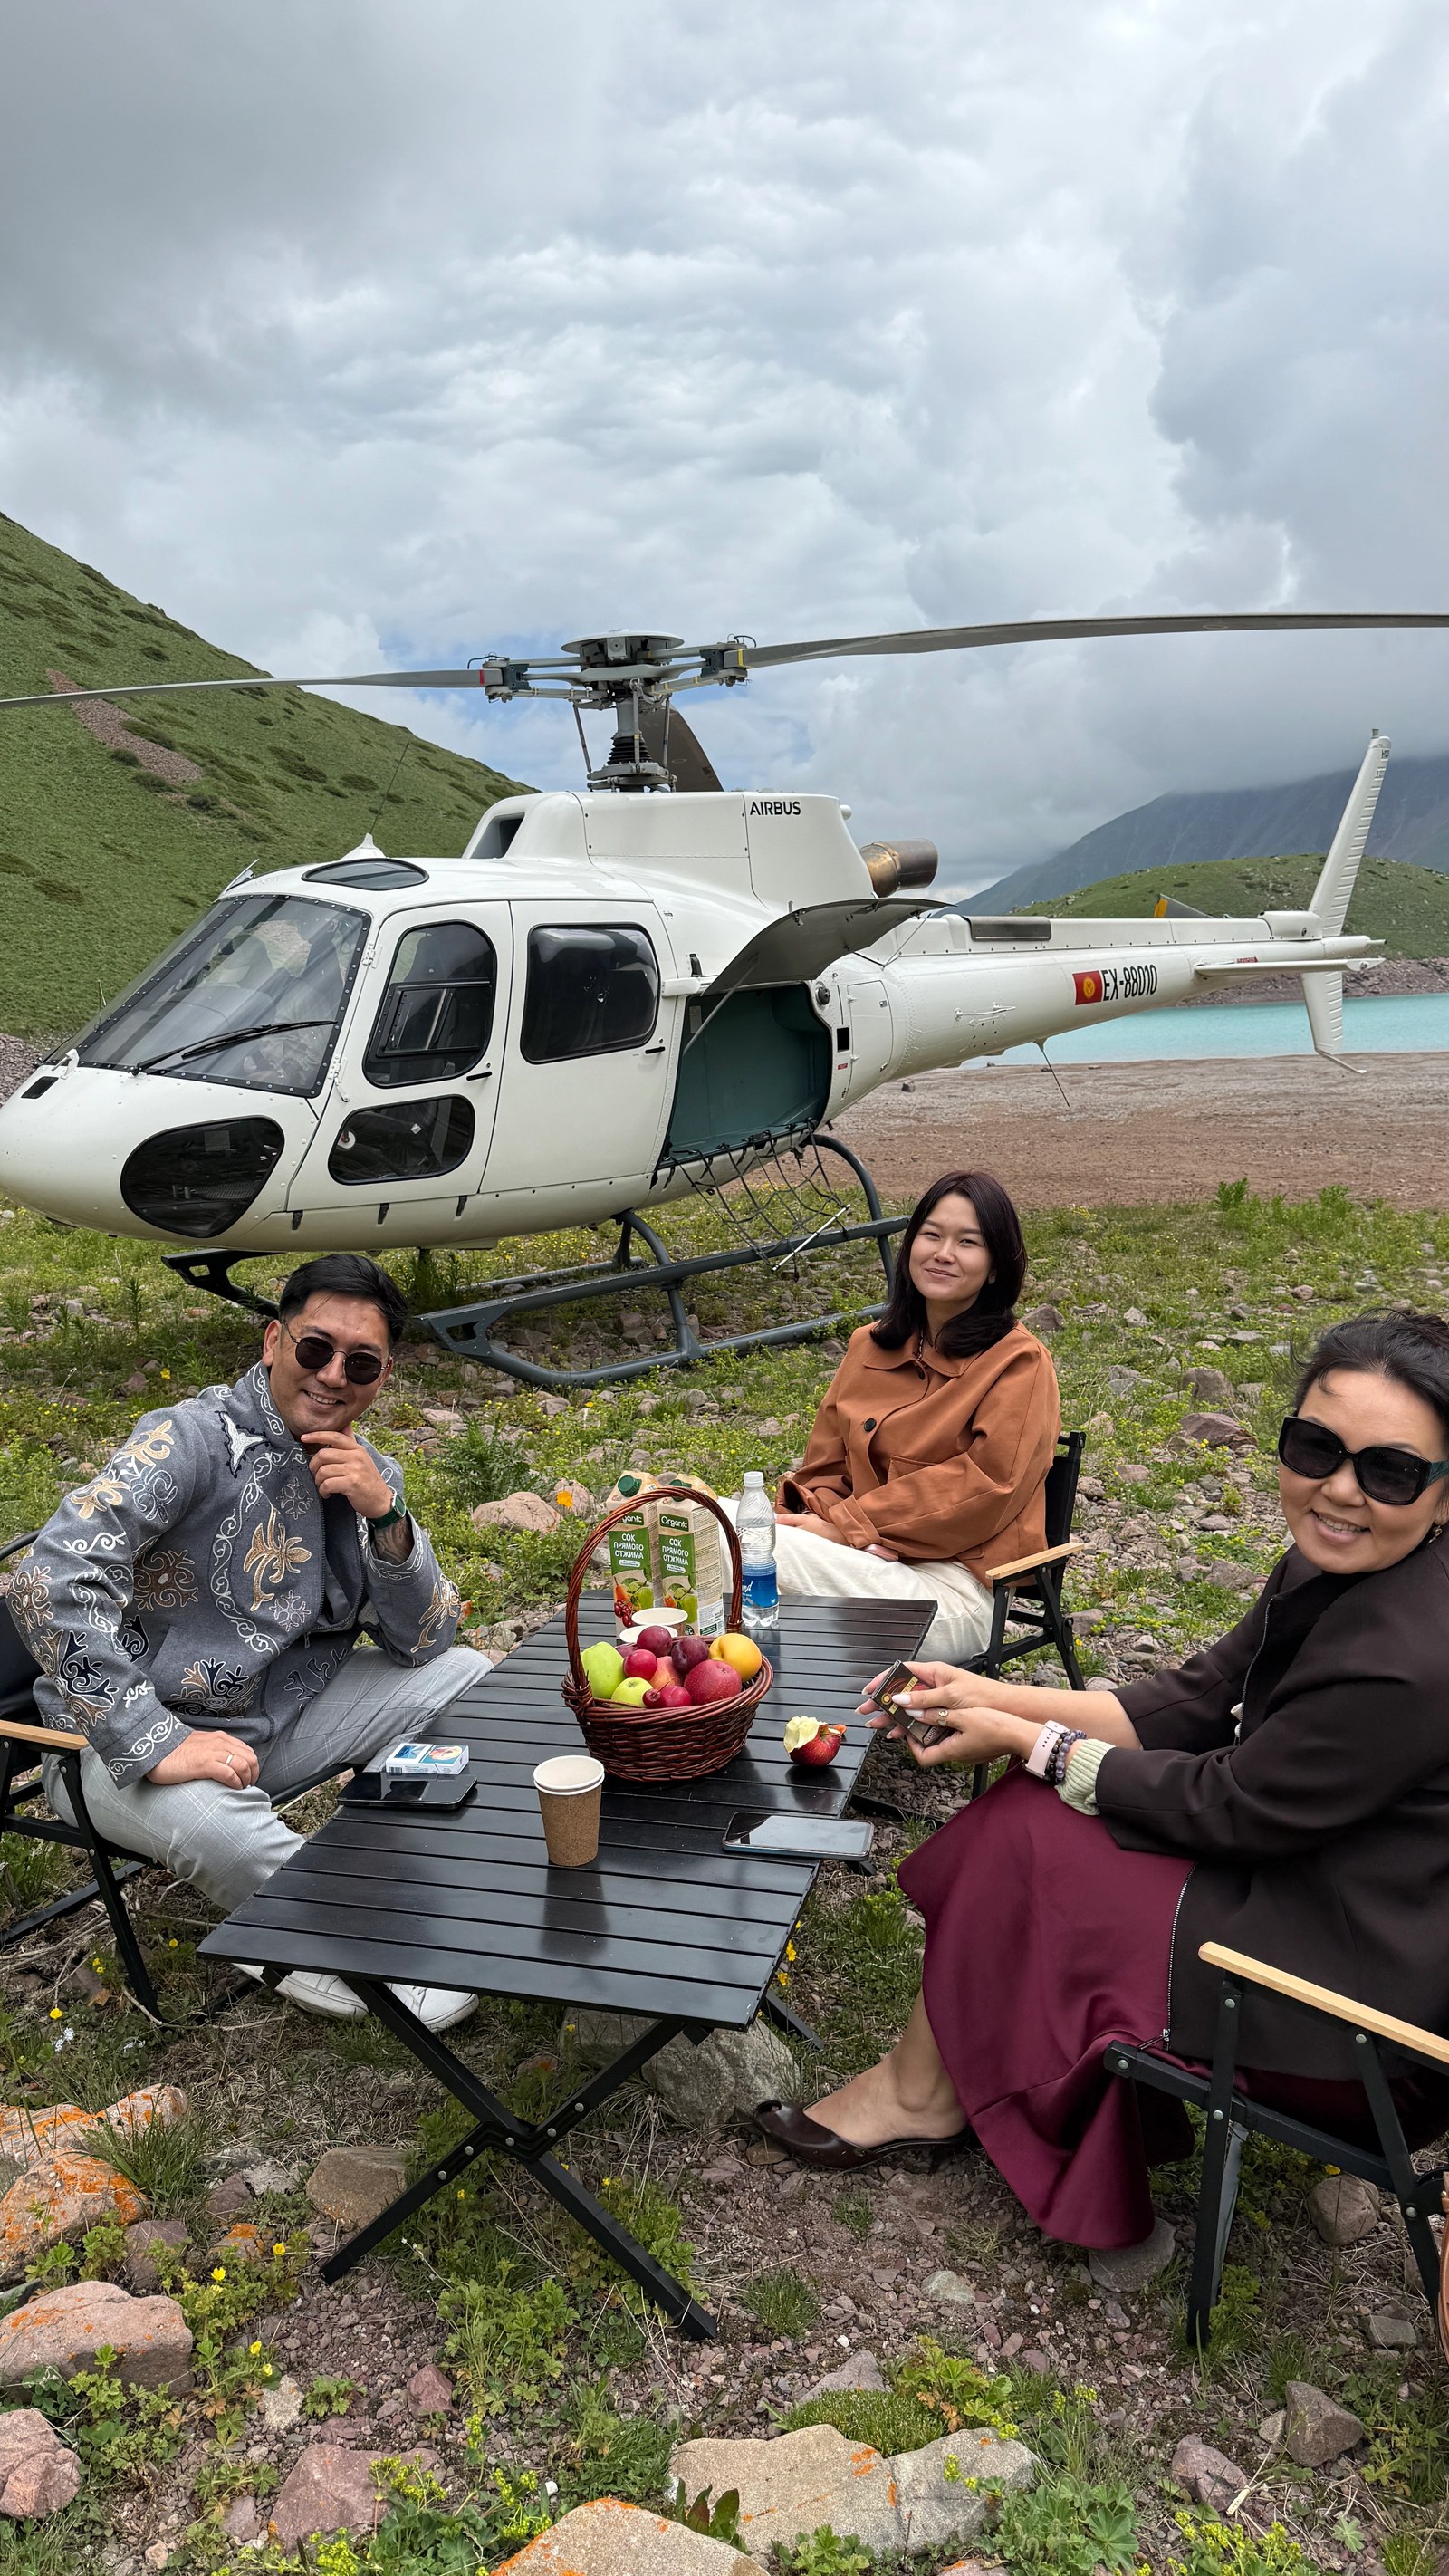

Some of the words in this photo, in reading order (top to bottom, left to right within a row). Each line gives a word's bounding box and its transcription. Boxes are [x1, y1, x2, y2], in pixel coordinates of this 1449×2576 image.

[750, 801, 801, 815] AIRBUS
[1101, 964, 1158, 1002] EX-88010
[661, 1515, 688, 1529] Organic
[621, 1533, 636, 1542] СОК
[669, 1538, 682, 1547] СОК
[613, 1541, 644, 1552] ПРЯМОГО
[662, 1545, 689, 1558] ПРЯМОГО
[614, 1550, 644, 1559] ОТЖИМА
[663, 1553, 689, 1565] ОТЖИМА
